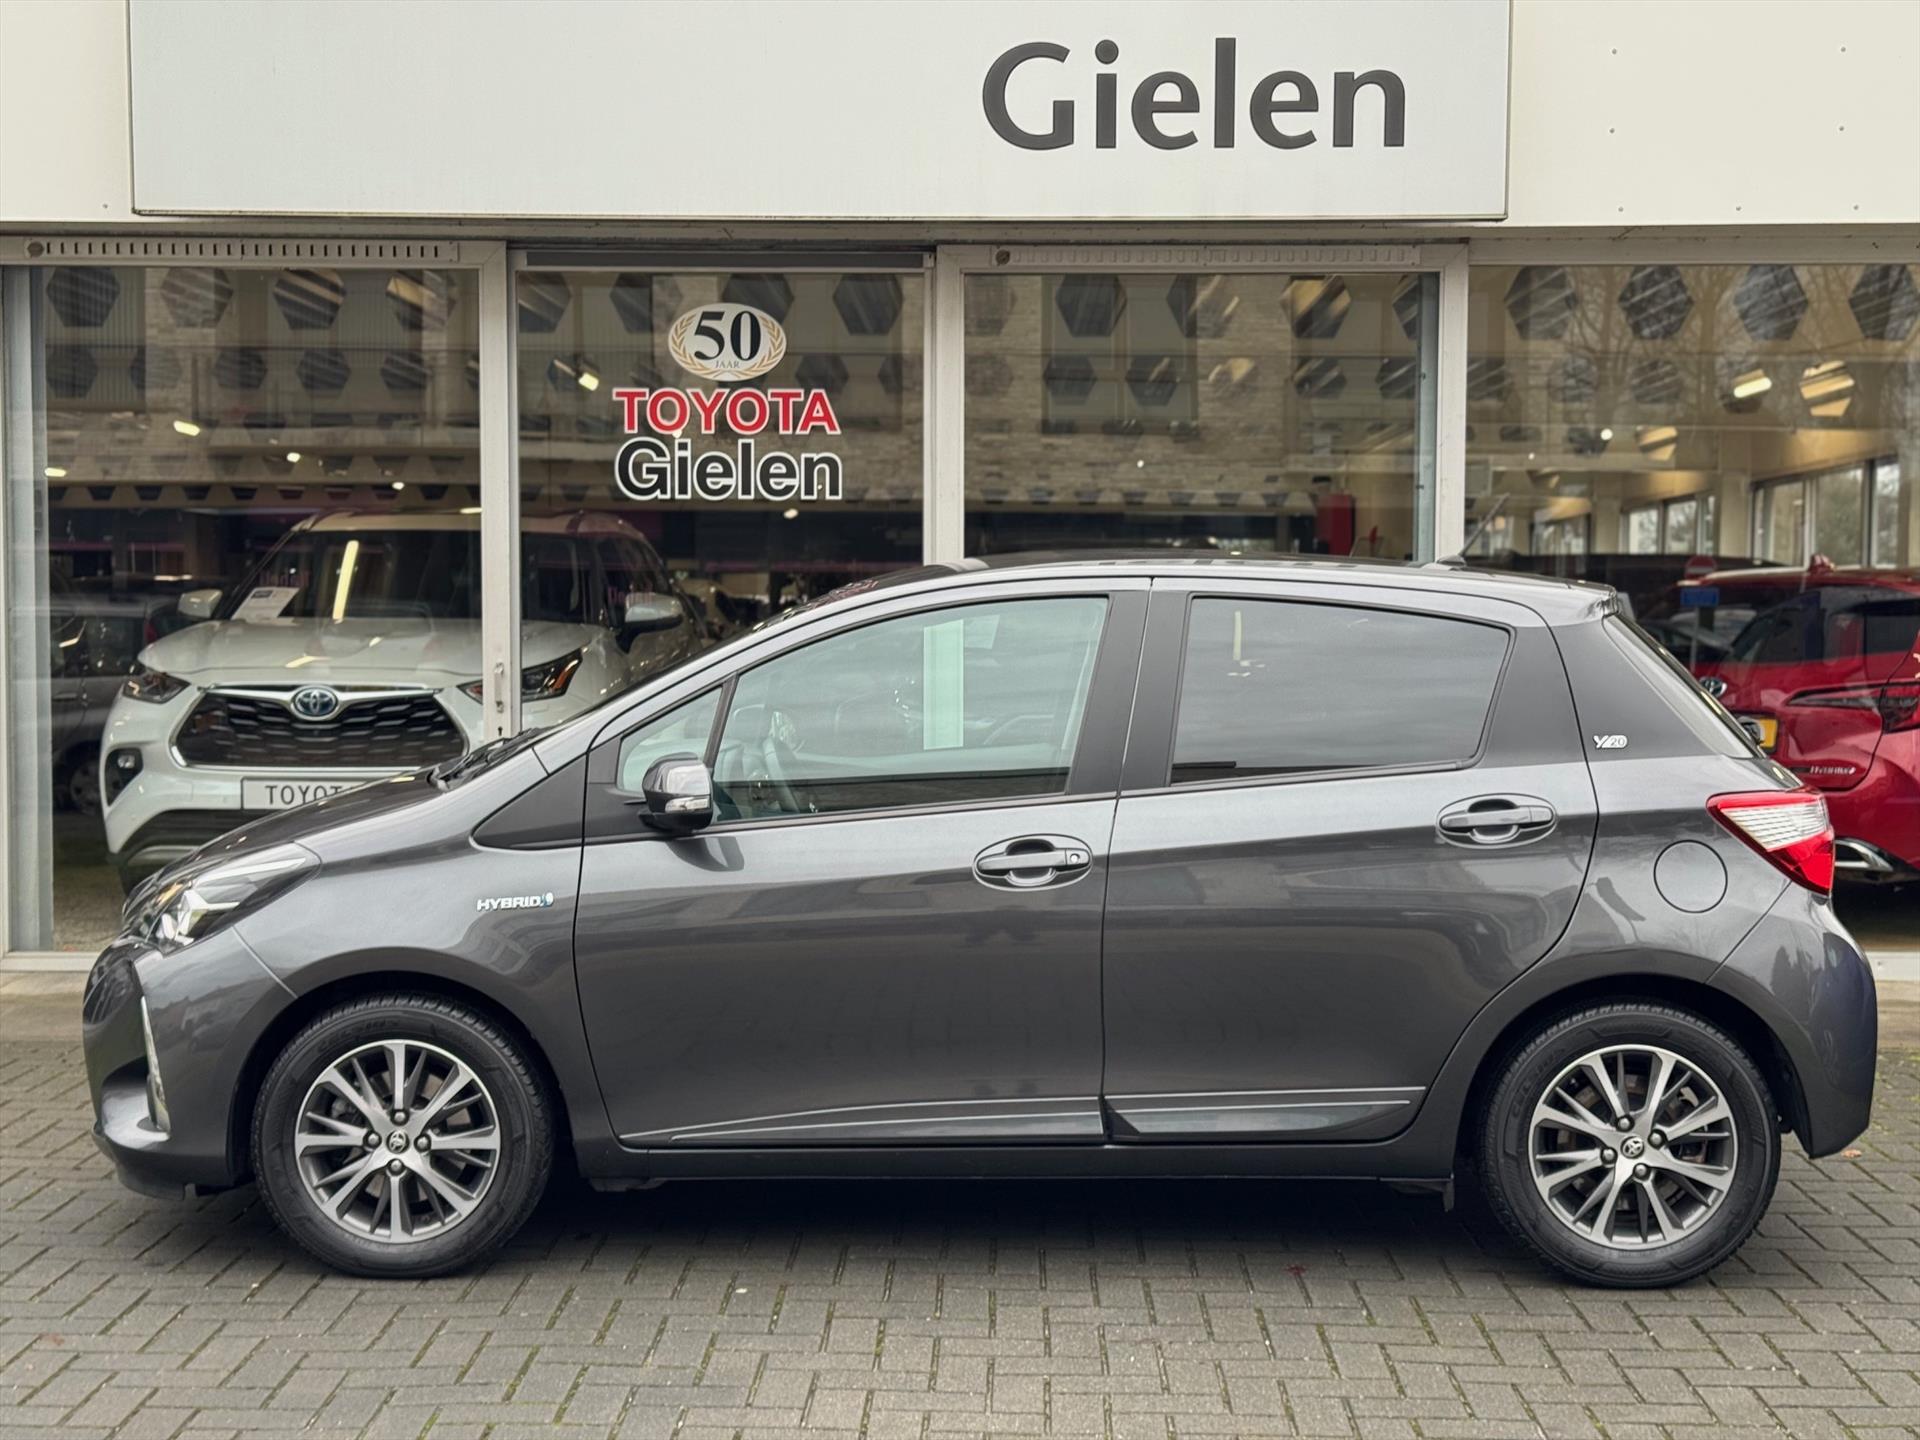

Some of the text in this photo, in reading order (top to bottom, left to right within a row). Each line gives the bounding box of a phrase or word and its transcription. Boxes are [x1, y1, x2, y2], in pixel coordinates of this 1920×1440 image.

[982, 37, 1406, 151] Gielen
[694, 310, 761, 361] 50
[715, 360, 740, 369] JAAR
[613, 388, 841, 435] TOYOTA
[615, 437, 842, 500] Gielen
[265, 785, 345, 805] TOYO
[476, 895, 542, 911] HYBRID
